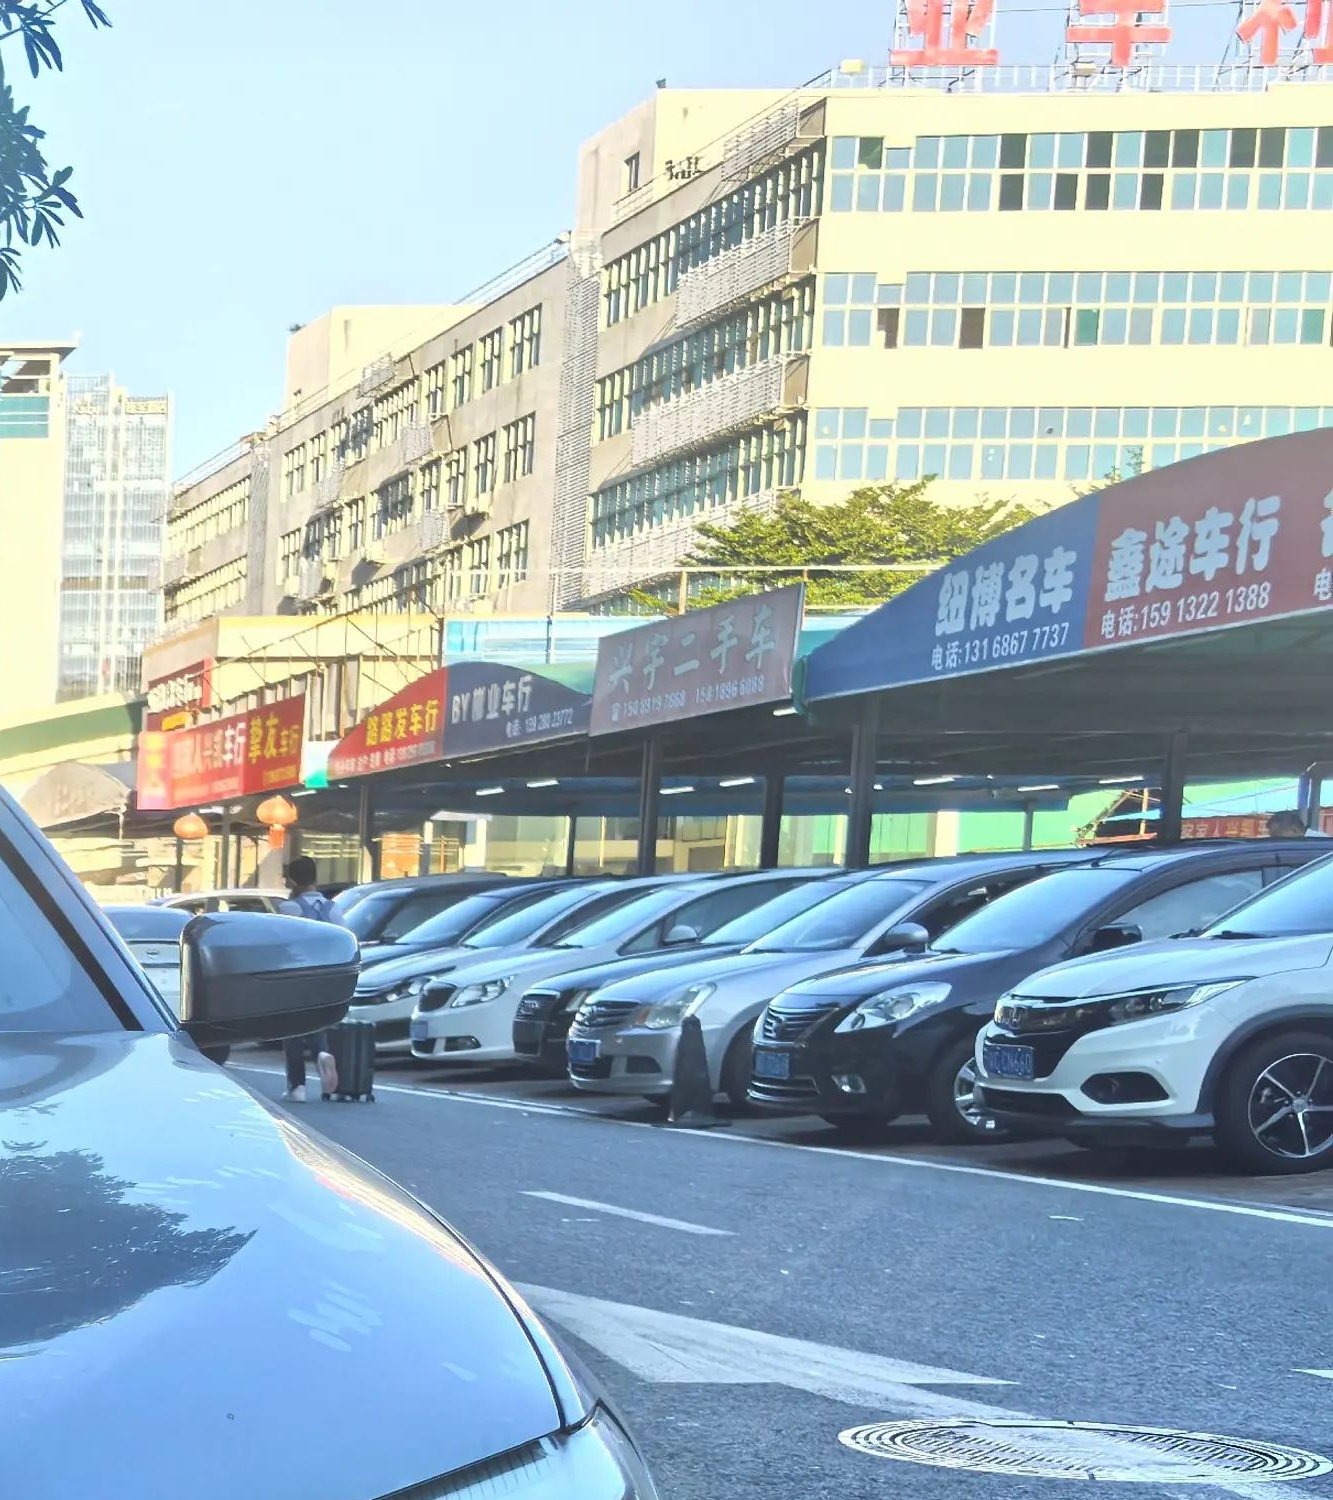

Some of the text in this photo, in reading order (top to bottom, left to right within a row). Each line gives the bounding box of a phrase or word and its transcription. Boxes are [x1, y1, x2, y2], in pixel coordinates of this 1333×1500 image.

[1104, 495, 1281, 602] 鑫途车行
[1177, 591, 1219, 623] 1322
[1225, 581, 1271, 613] 1388
[609, 603, 776, 694] 兴宇二手车
[992, 630, 1027, 658] 6867
[1032, 622, 1069, 651] 7737
